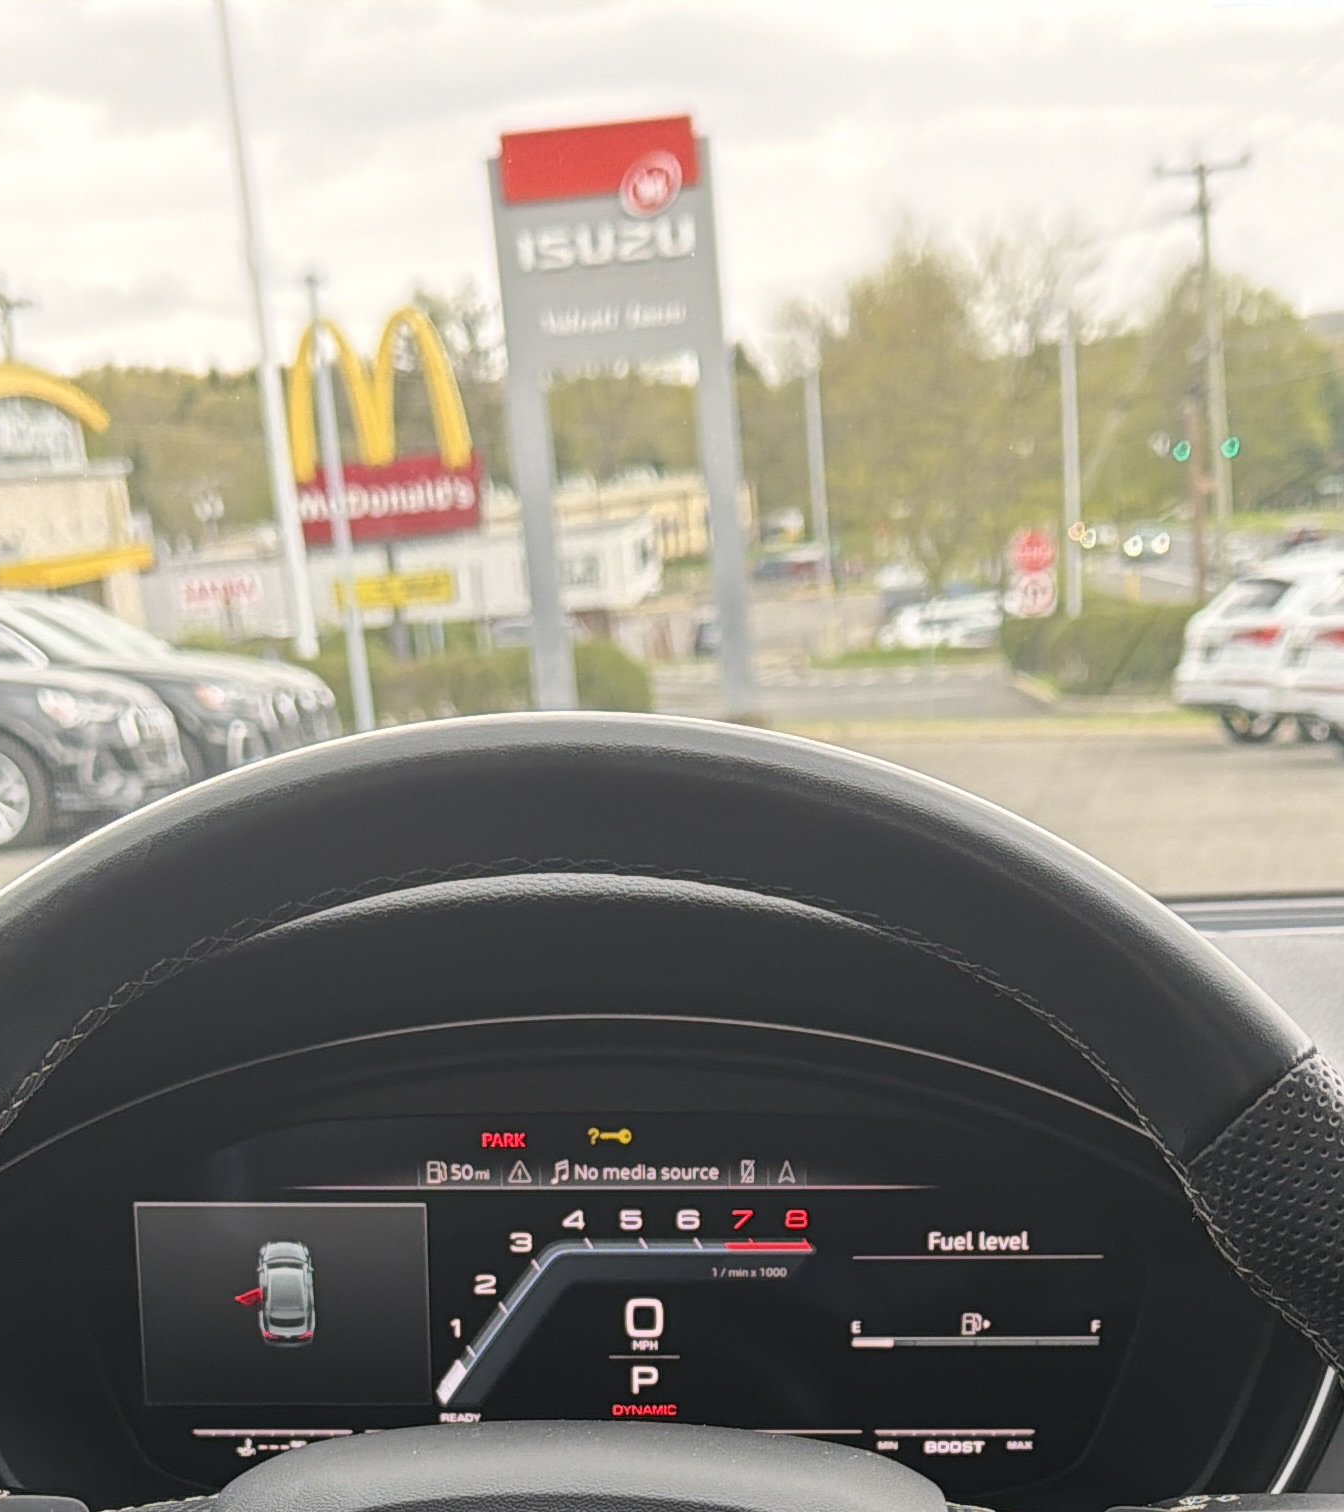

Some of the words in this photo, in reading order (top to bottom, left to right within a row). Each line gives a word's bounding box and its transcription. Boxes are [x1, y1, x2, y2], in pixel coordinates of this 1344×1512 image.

[517, 214, 696, 273] ISUZU
[481, 1132, 527, 1148] PARK
[450, 1163, 474, 1181] 50
[475, 1168, 491, 1181] mi
[574, 1164, 599, 1181] No
[603, 1162, 657, 1181] media
[661, 1167, 720, 1181] source
[561, 1209, 586, 1231] 4
[619, 1209, 643, 1230] 5
[676, 1209, 701, 1230] 6
[730, 1209, 755, 1230] 7
[784, 1209, 809, 1230] 8
[509, 1232, 533, 1253] 3
[927, 1231, 974, 1251] Fuel
[979, 1231, 1030, 1251] level
[728, 1267, 751, 1278] min
[761, 1267, 787, 1278] 1000
[474, 1274, 497, 1295] 2
[624, 1298, 665, 1338] 0
[850, 1320, 861, 1334] E
[1090, 1320, 1101, 1333] F
[450, 1318, 462, 1338] 1
[632, 1340, 659, 1351] MPH
[631, 1366, 659, 1395] P
[439, 1412, 481, 1424] READY
[611, 1404, 678, 1418] DYNAMIC
[876, 1440, 898, 1451] MIN
[922, 1440, 986, 1454] BOOST
[1006, 1440, 1033, 1450] MAX
